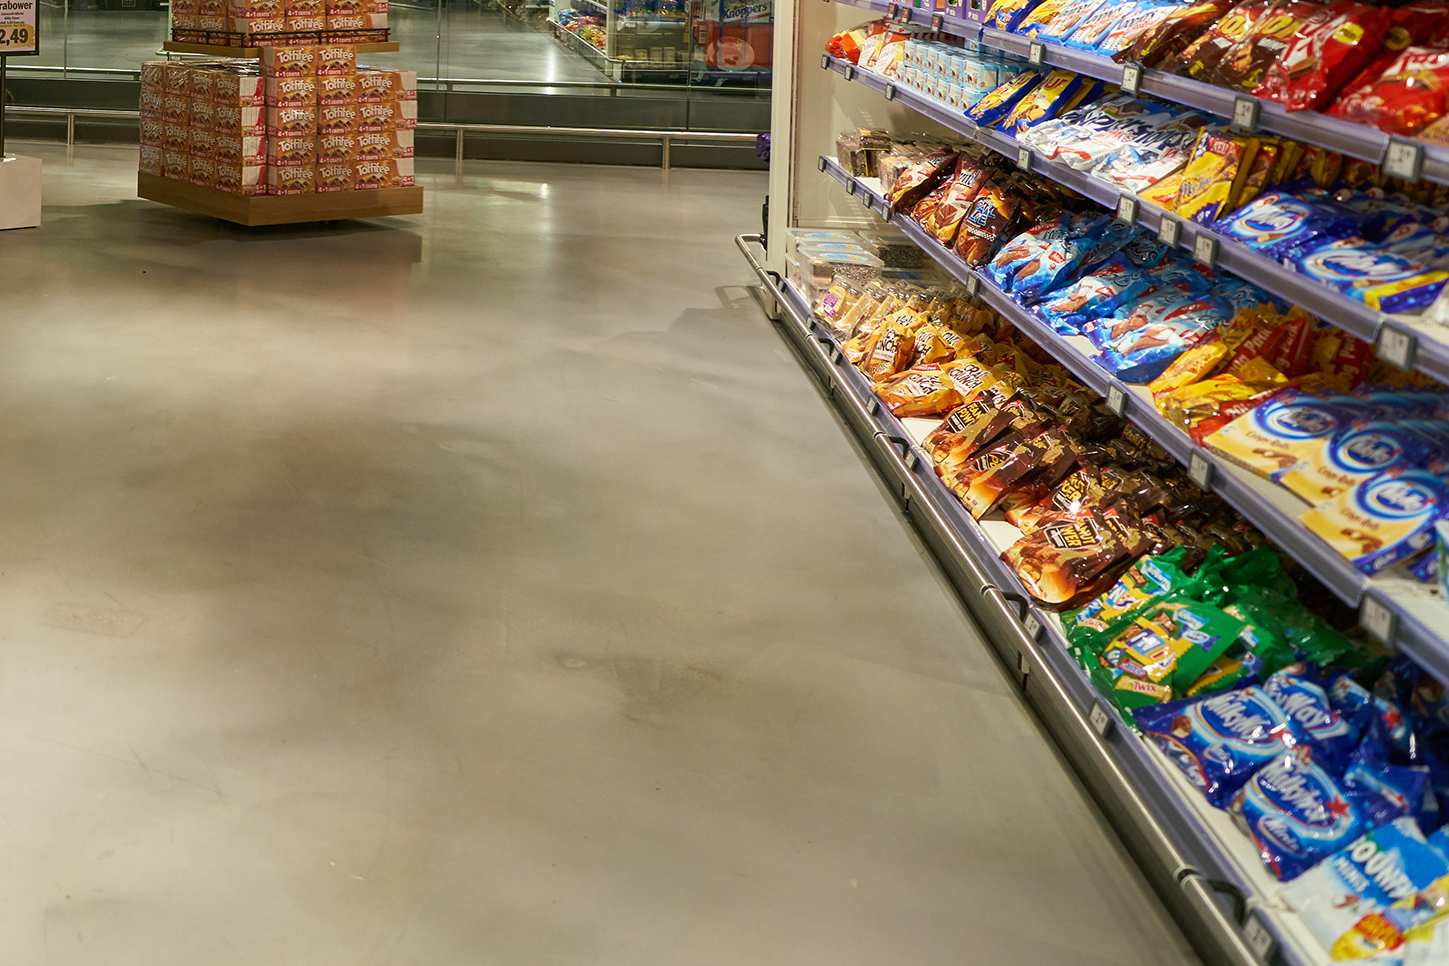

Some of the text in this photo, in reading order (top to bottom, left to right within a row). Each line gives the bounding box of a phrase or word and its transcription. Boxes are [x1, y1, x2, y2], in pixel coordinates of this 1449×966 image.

[724, 3, 768, 19] Knoppers
[249, 20, 284, 33] Toffifee
[289, 18, 324, 30] Toffifee
[330, 16, 363, 29] Toffifee
[276, 49, 314, 64] Toffifee
[319, 48, 354, 62] Toffifee
[279, 80, 315, 93] Toffifee
[323, 78, 356, 92] Toffifee
[359, 76, 393, 89] Toffifee
[323, 107, 356, 120] Toffifee
[360, 104, 394, 118] Toffifee
[278, 138, 315, 152] Toffifee
[321, 136, 355, 149] Toffifee
[1132, 681, 1157, 693] TWIX
